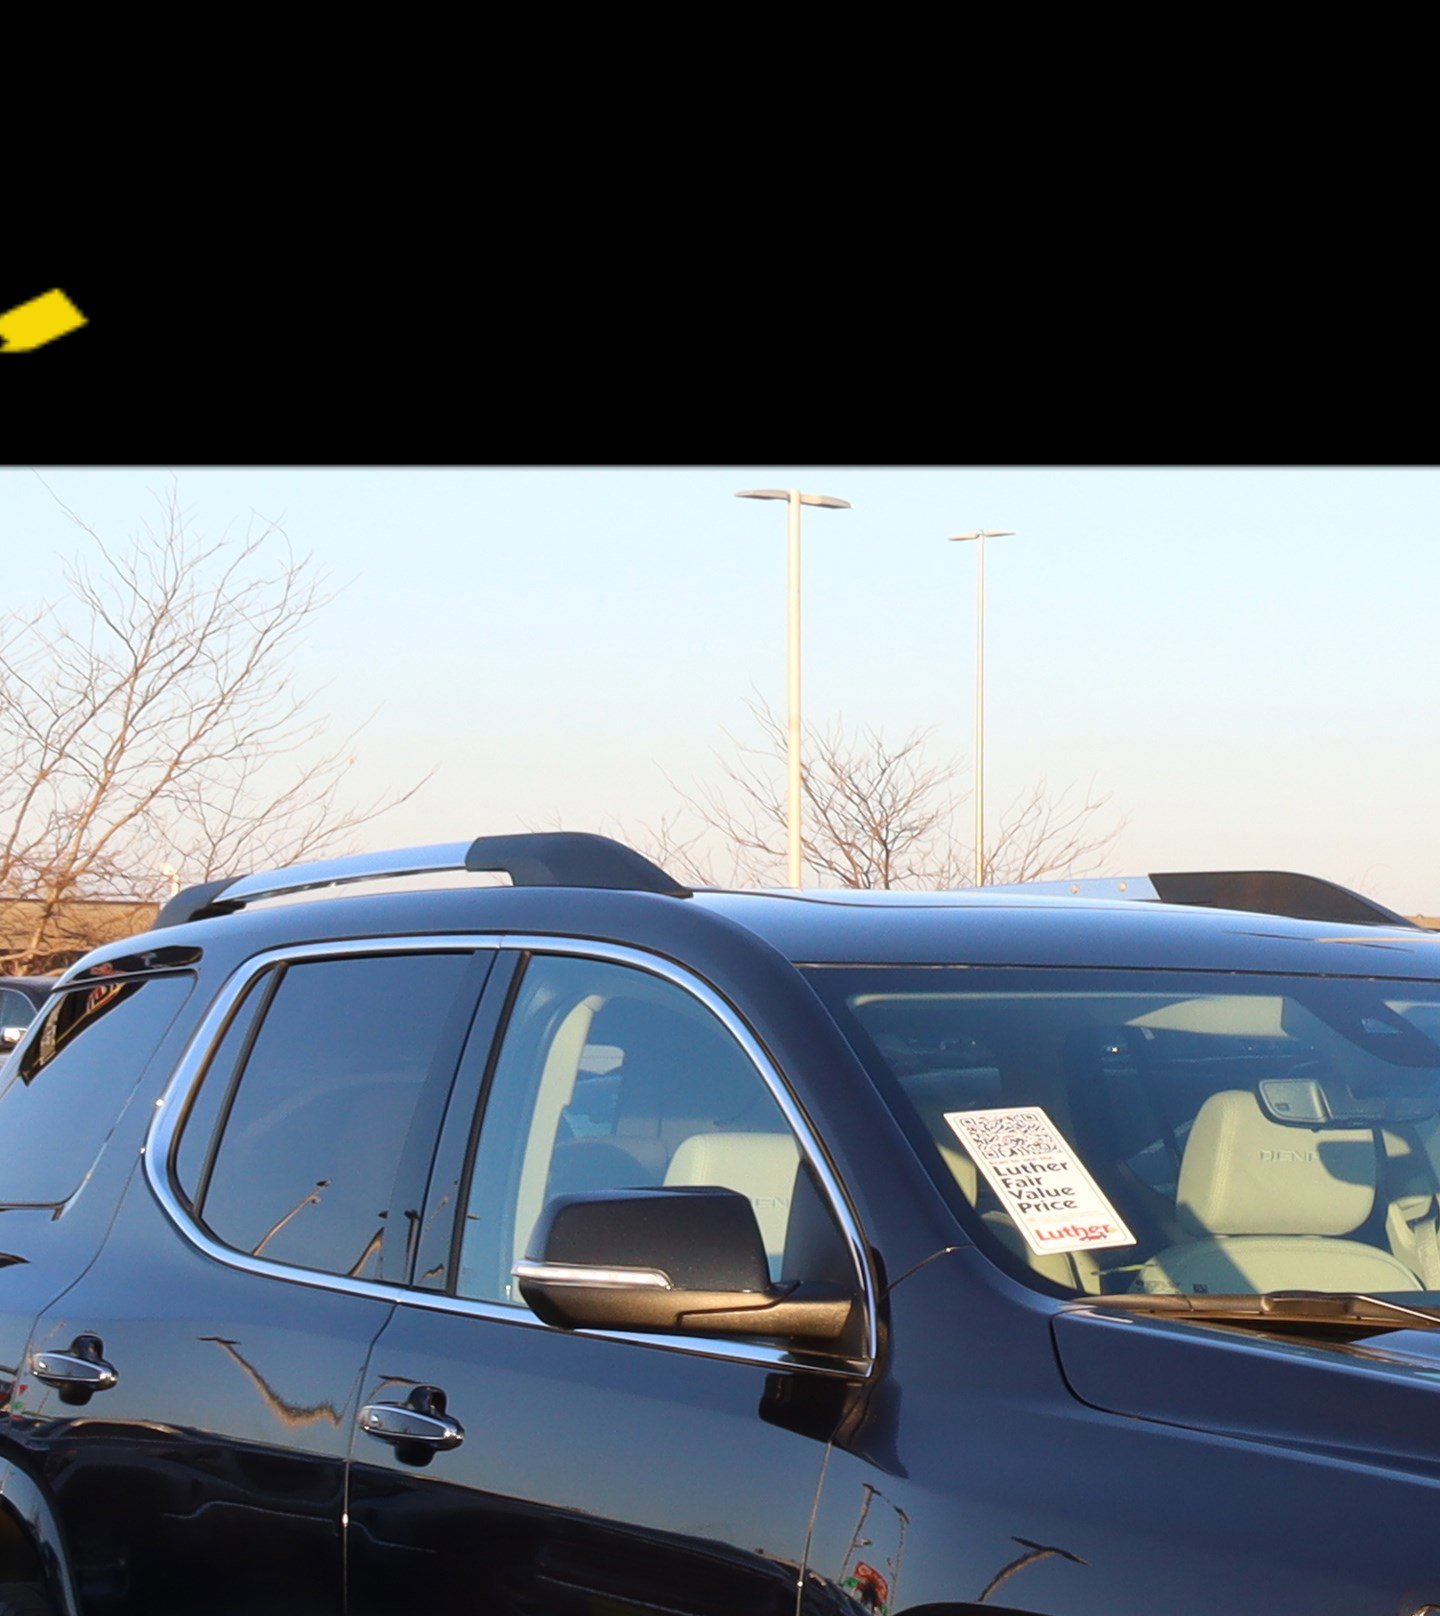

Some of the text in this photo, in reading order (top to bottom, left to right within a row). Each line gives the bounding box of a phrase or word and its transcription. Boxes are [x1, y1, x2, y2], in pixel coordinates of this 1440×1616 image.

[992, 1161, 1069, 1177] Luther
[1000, 1175, 1043, 1189] Fair
[1007, 1186, 1076, 1201] Value
[1017, 1199, 1078, 1214] Price
[1034, 1223, 1111, 1241] Luther
